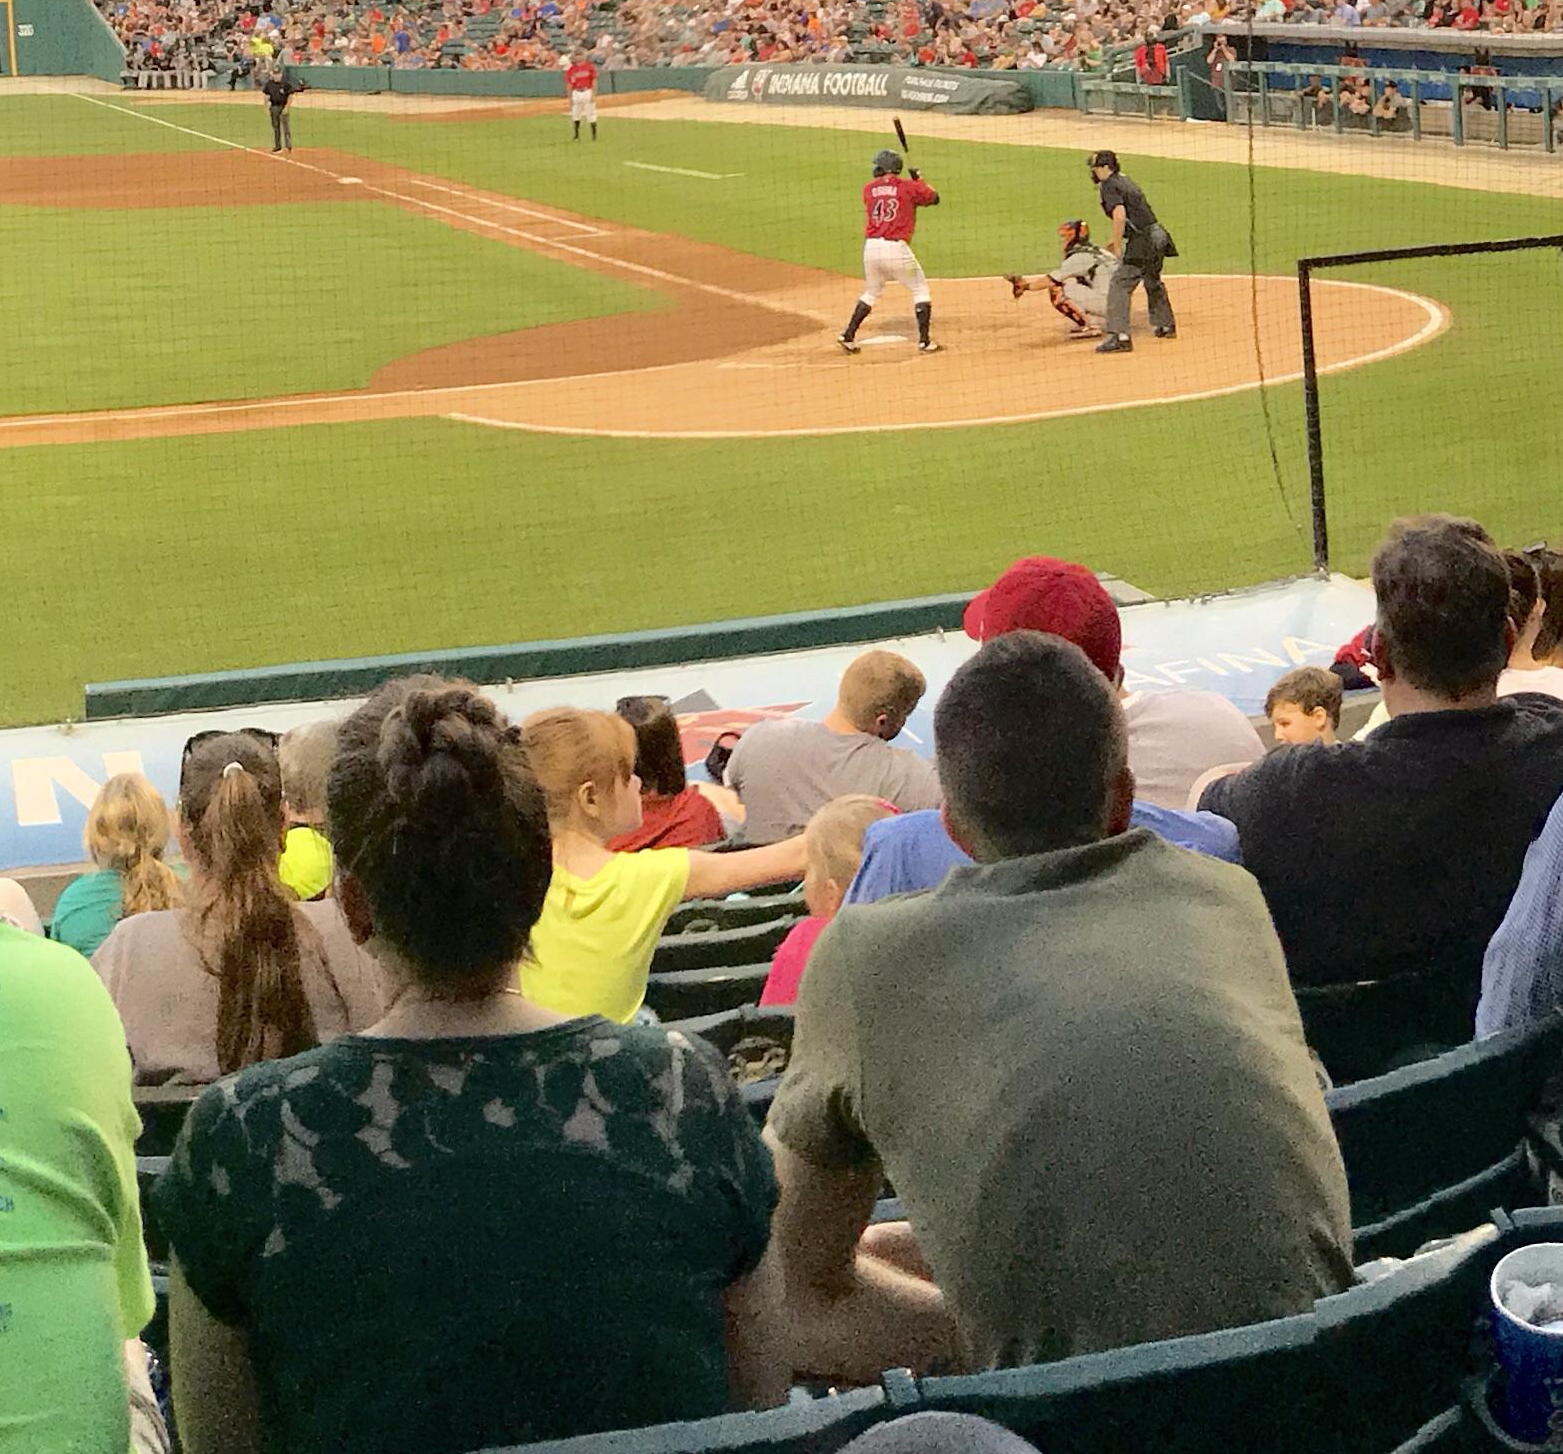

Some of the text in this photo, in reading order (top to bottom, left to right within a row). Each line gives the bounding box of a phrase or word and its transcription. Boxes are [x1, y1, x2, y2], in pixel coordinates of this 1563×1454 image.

[768, 72, 890, 97] INDIANA FOOTBALL
[872, 198, 900, 227] 43
